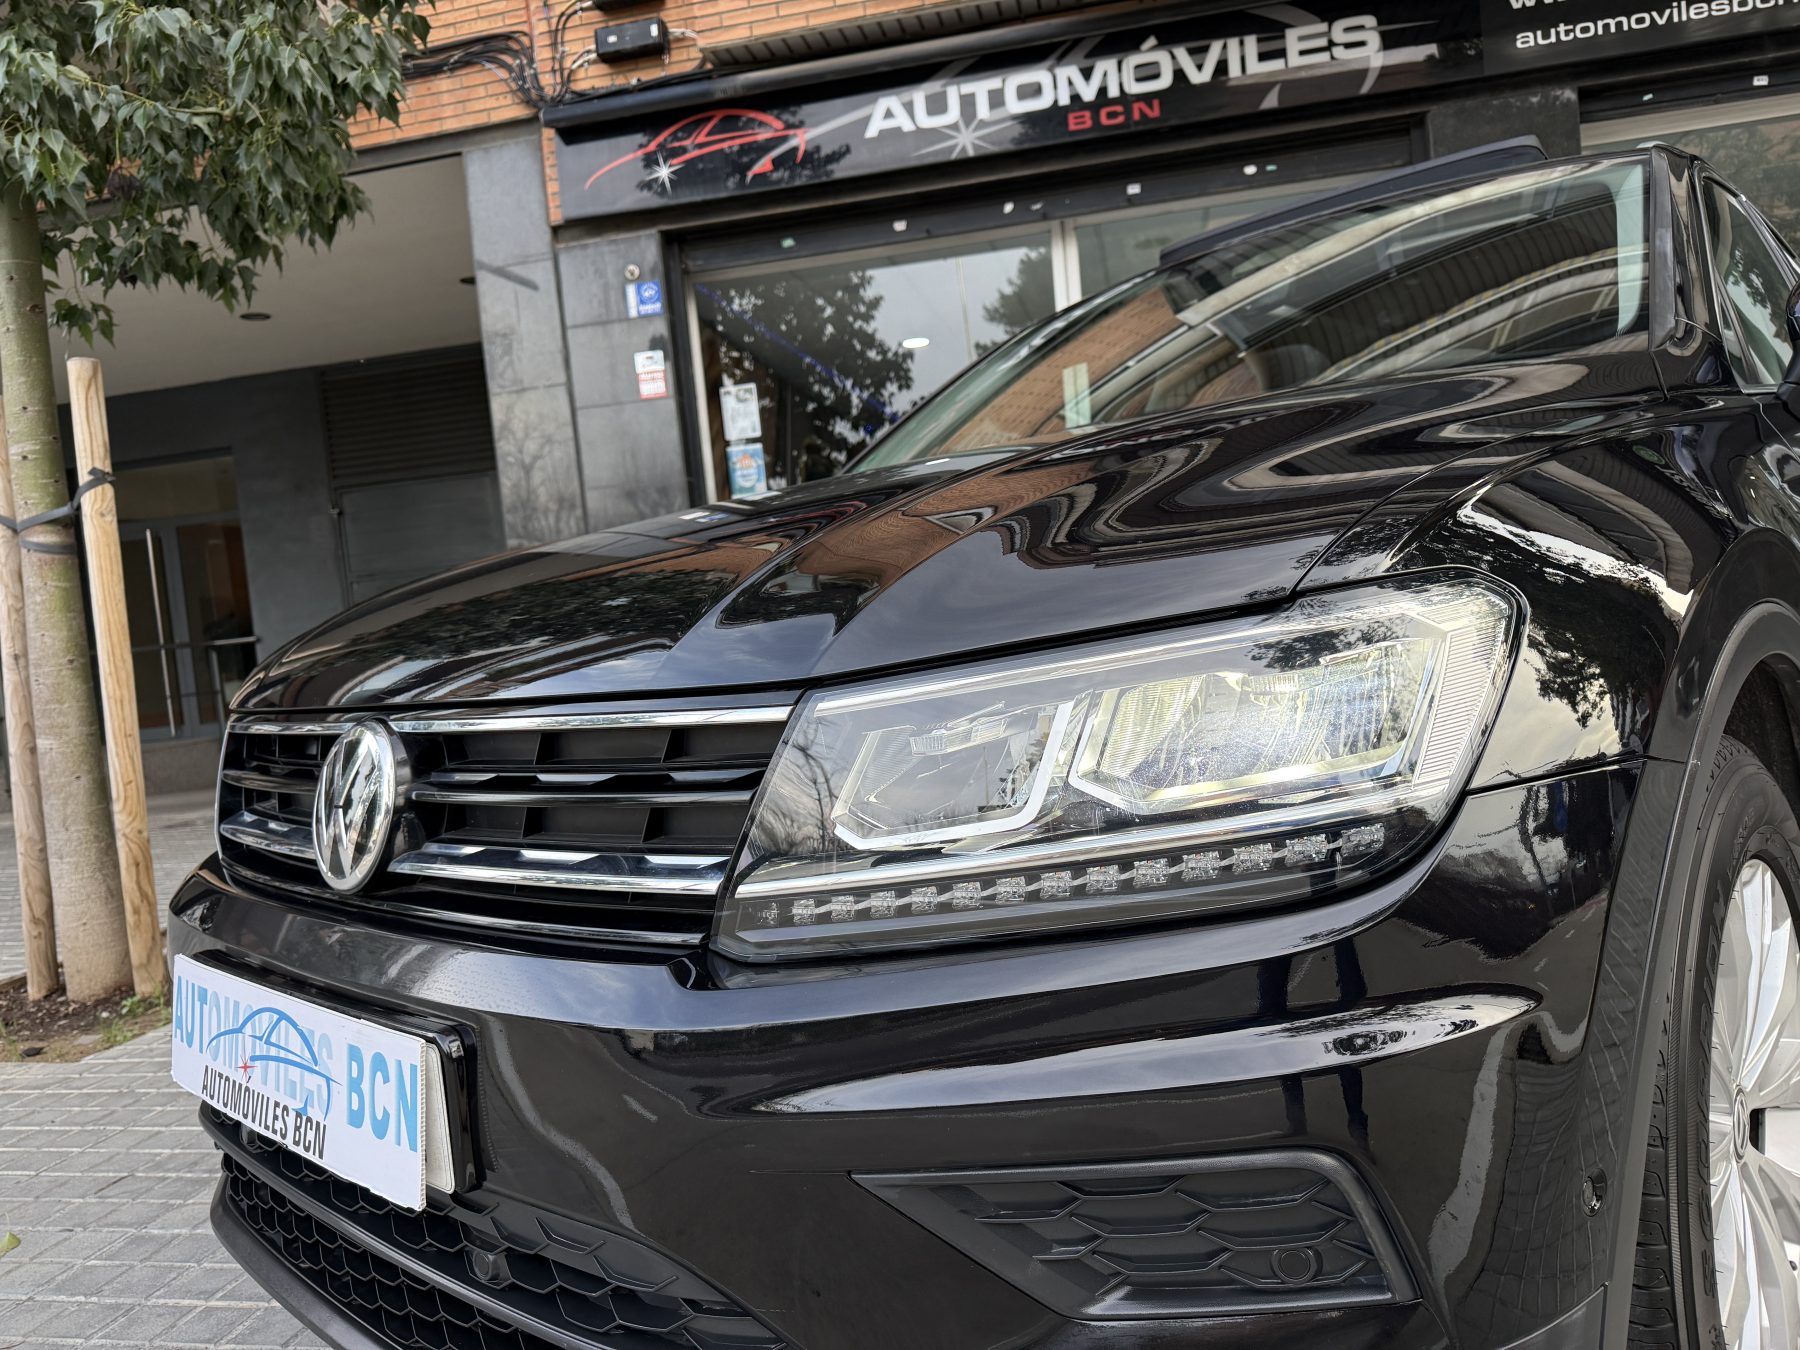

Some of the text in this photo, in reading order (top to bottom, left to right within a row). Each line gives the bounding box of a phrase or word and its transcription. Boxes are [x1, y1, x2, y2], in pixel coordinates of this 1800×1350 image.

[864, 14, 1381, 139] AUTOMÓVILES
[1067, 99, 1161, 132] BCN
[174, 976, 418, 1153] AUTOMOVILES BCN
[201, 1064, 327, 1160] AUTOMÓVILES BCN
